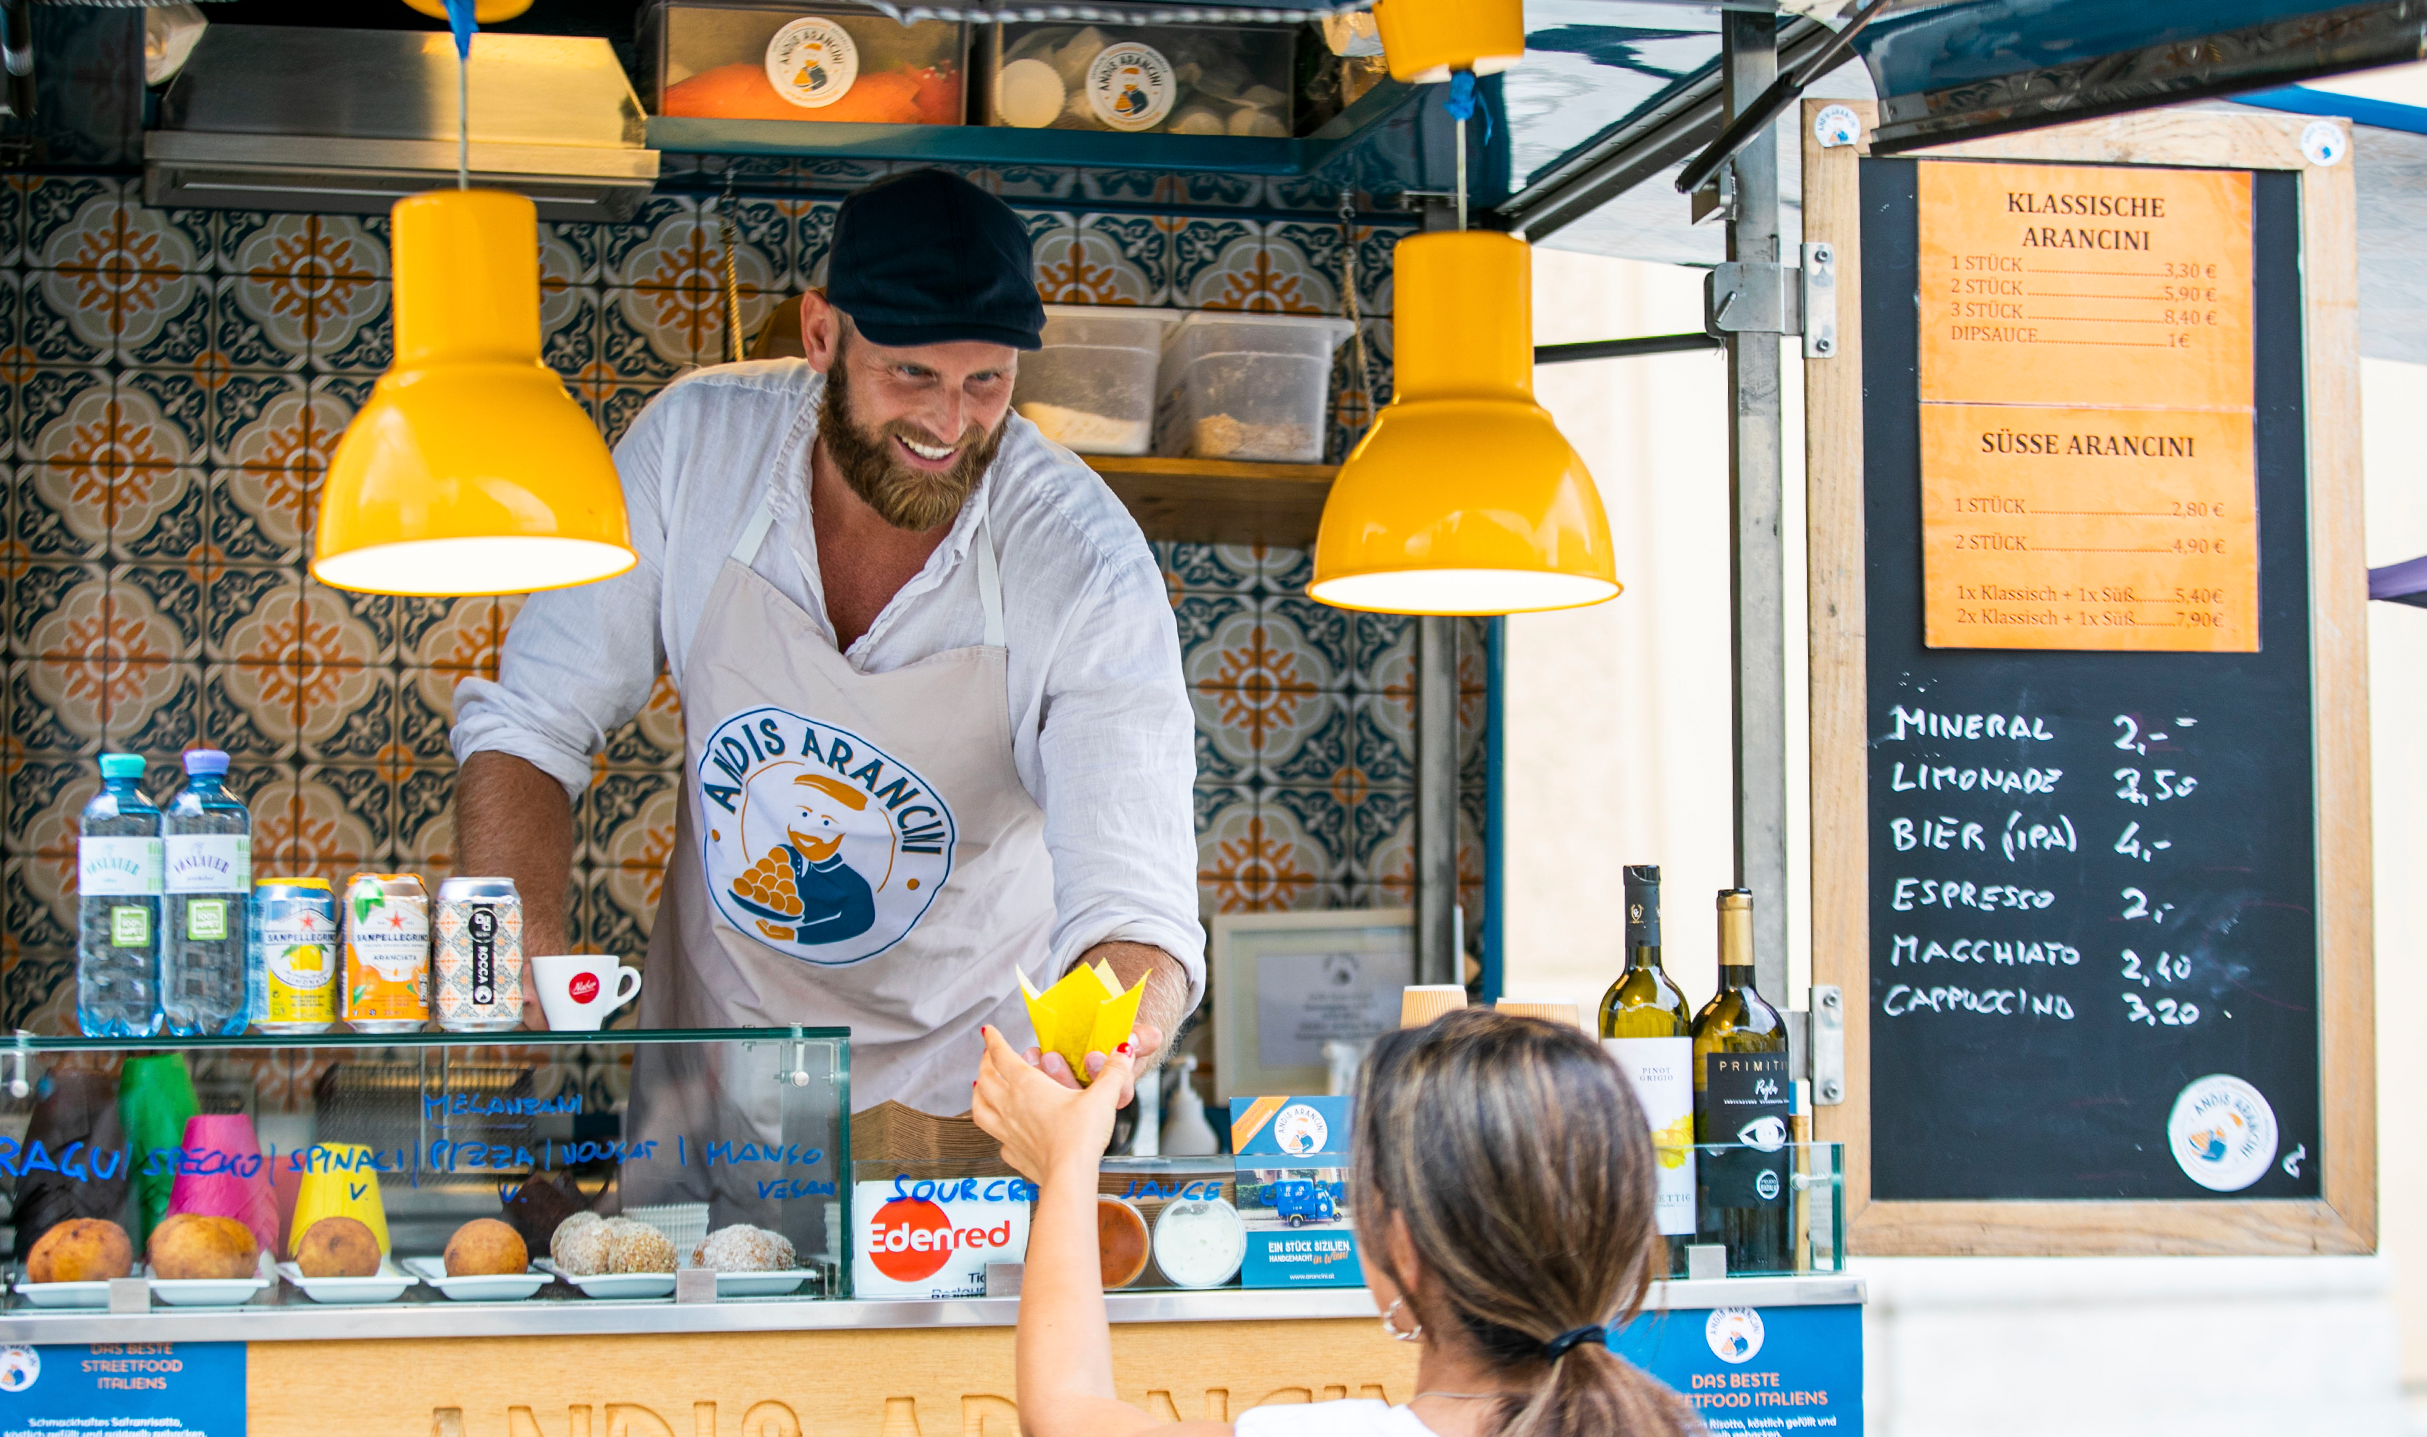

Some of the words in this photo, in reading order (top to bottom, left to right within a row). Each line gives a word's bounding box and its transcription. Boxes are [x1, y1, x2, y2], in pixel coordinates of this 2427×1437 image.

[2007, 192, 2166, 218] KLASSISCHE
[2022, 227, 2150, 251] ARANCINI
[1951, 256, 1959, 271] 1
[1965, 254, 2023, 273] STÜCK
[2164, 263, 2199, 280] 3,30
[2205, 264, 2217, 279] €
[1951, 279, 1960, 294] 2
[1965, 277, 2023, 296] STÜCK
[2164, 287, 2200, 303] 5,90
[2205, 288, 2218, 302] €
[1950, 302, 1960, 318] 3
[1965, 300, 2023, 319] STÜCK
[2164, 310, 2200, 327] 8,40
[2205, 311, 2218, 326] €
[1951, 326, 2038, 344] DIPSAUCE
[1982, 429, 2059, 455] SÜSSE
[2067, 435, 2195, 458] ARANCINI
[1955, 498, 1962, 513] 1
[1969, 496, 2026, 515] STÜCK
[2172, 502, 2207, 518] 2,80
[2213, 503, 2225, 517] €
[1955, 535, 1964, 550] 2
[1970, 533, 2027, 552] STÜCK
[2173, 539, 2209, 556] 4,90
[2214, 540, 2226, 555] €
[1958, 585, 1976, 600] 1x
[1980, 584, 2057, 602] Klassisch
[2063, 590, 2073, 601] +
[2079, 587, 2098, 602] 1x
[1958, 609, 1976, 625] 2x
[1980, 608, 2058, 626] Klassisch
[2063, 614, 2073, 625] +
[2080, 611, 2099, 626] 1x
[1889, 705, 2053, 741] MINERAL
[704, 718, 786, 815] ANDIS
[1891, 762, 2063, 794] LIMONADE
[1890, 815, 1986, 851] BIER
[1891, 877, 2055, 911] ESPRESSO
[1890, 934, 2080, 967] MACCHIATO
[2121, 948, 2192, 988] 2,40
[1883, 984, 2075, 1020] CAPPUCCINO
[2121, 992, 2200, 1027] 3,20
[1639, 1074, 1674, 1082] GRIGIO
[1642, 1067, 1672, 1075] PINOT
[1278, 1111, 1293, 1134] ANDIS
[1294, 1108, 1325, 1134] ARANCINI
[0, 1135, 120, 1183] RAGU
[288, 1145, 403, 1175] SPINACI
[430, 1138, 534, 1172] PIZZA
[868, 1220, 1011, 1254] Edenred
[1268, 1242, 1283, 1253] EIN
[1285, 1240, 1312, 1253] STÜCK
[1269, 1254, 1313, 1263] HANDGEMACHT
[1289, 1272, 1336, 1281] www.arancini.at
[126, 1343, 174, 1355] BESTE
[81, 1359, 183, 1373] STREETFOOD
[97, 1377, 167, 1390] ITALIENS
[1692, 1373, 1727, 1390] DAS
[1730, 1372, 1780, 1388] BESTE
[1755, 1390, 1829, 1407] ITALIENS
[1709, 1417, 1746, 1431] Risotto,
[1747, 1416, 1785, 1429] köstlich
[1786, 1415, 1817, 1430] gefüllt
[1818, 1415, 1837, 1427] und
